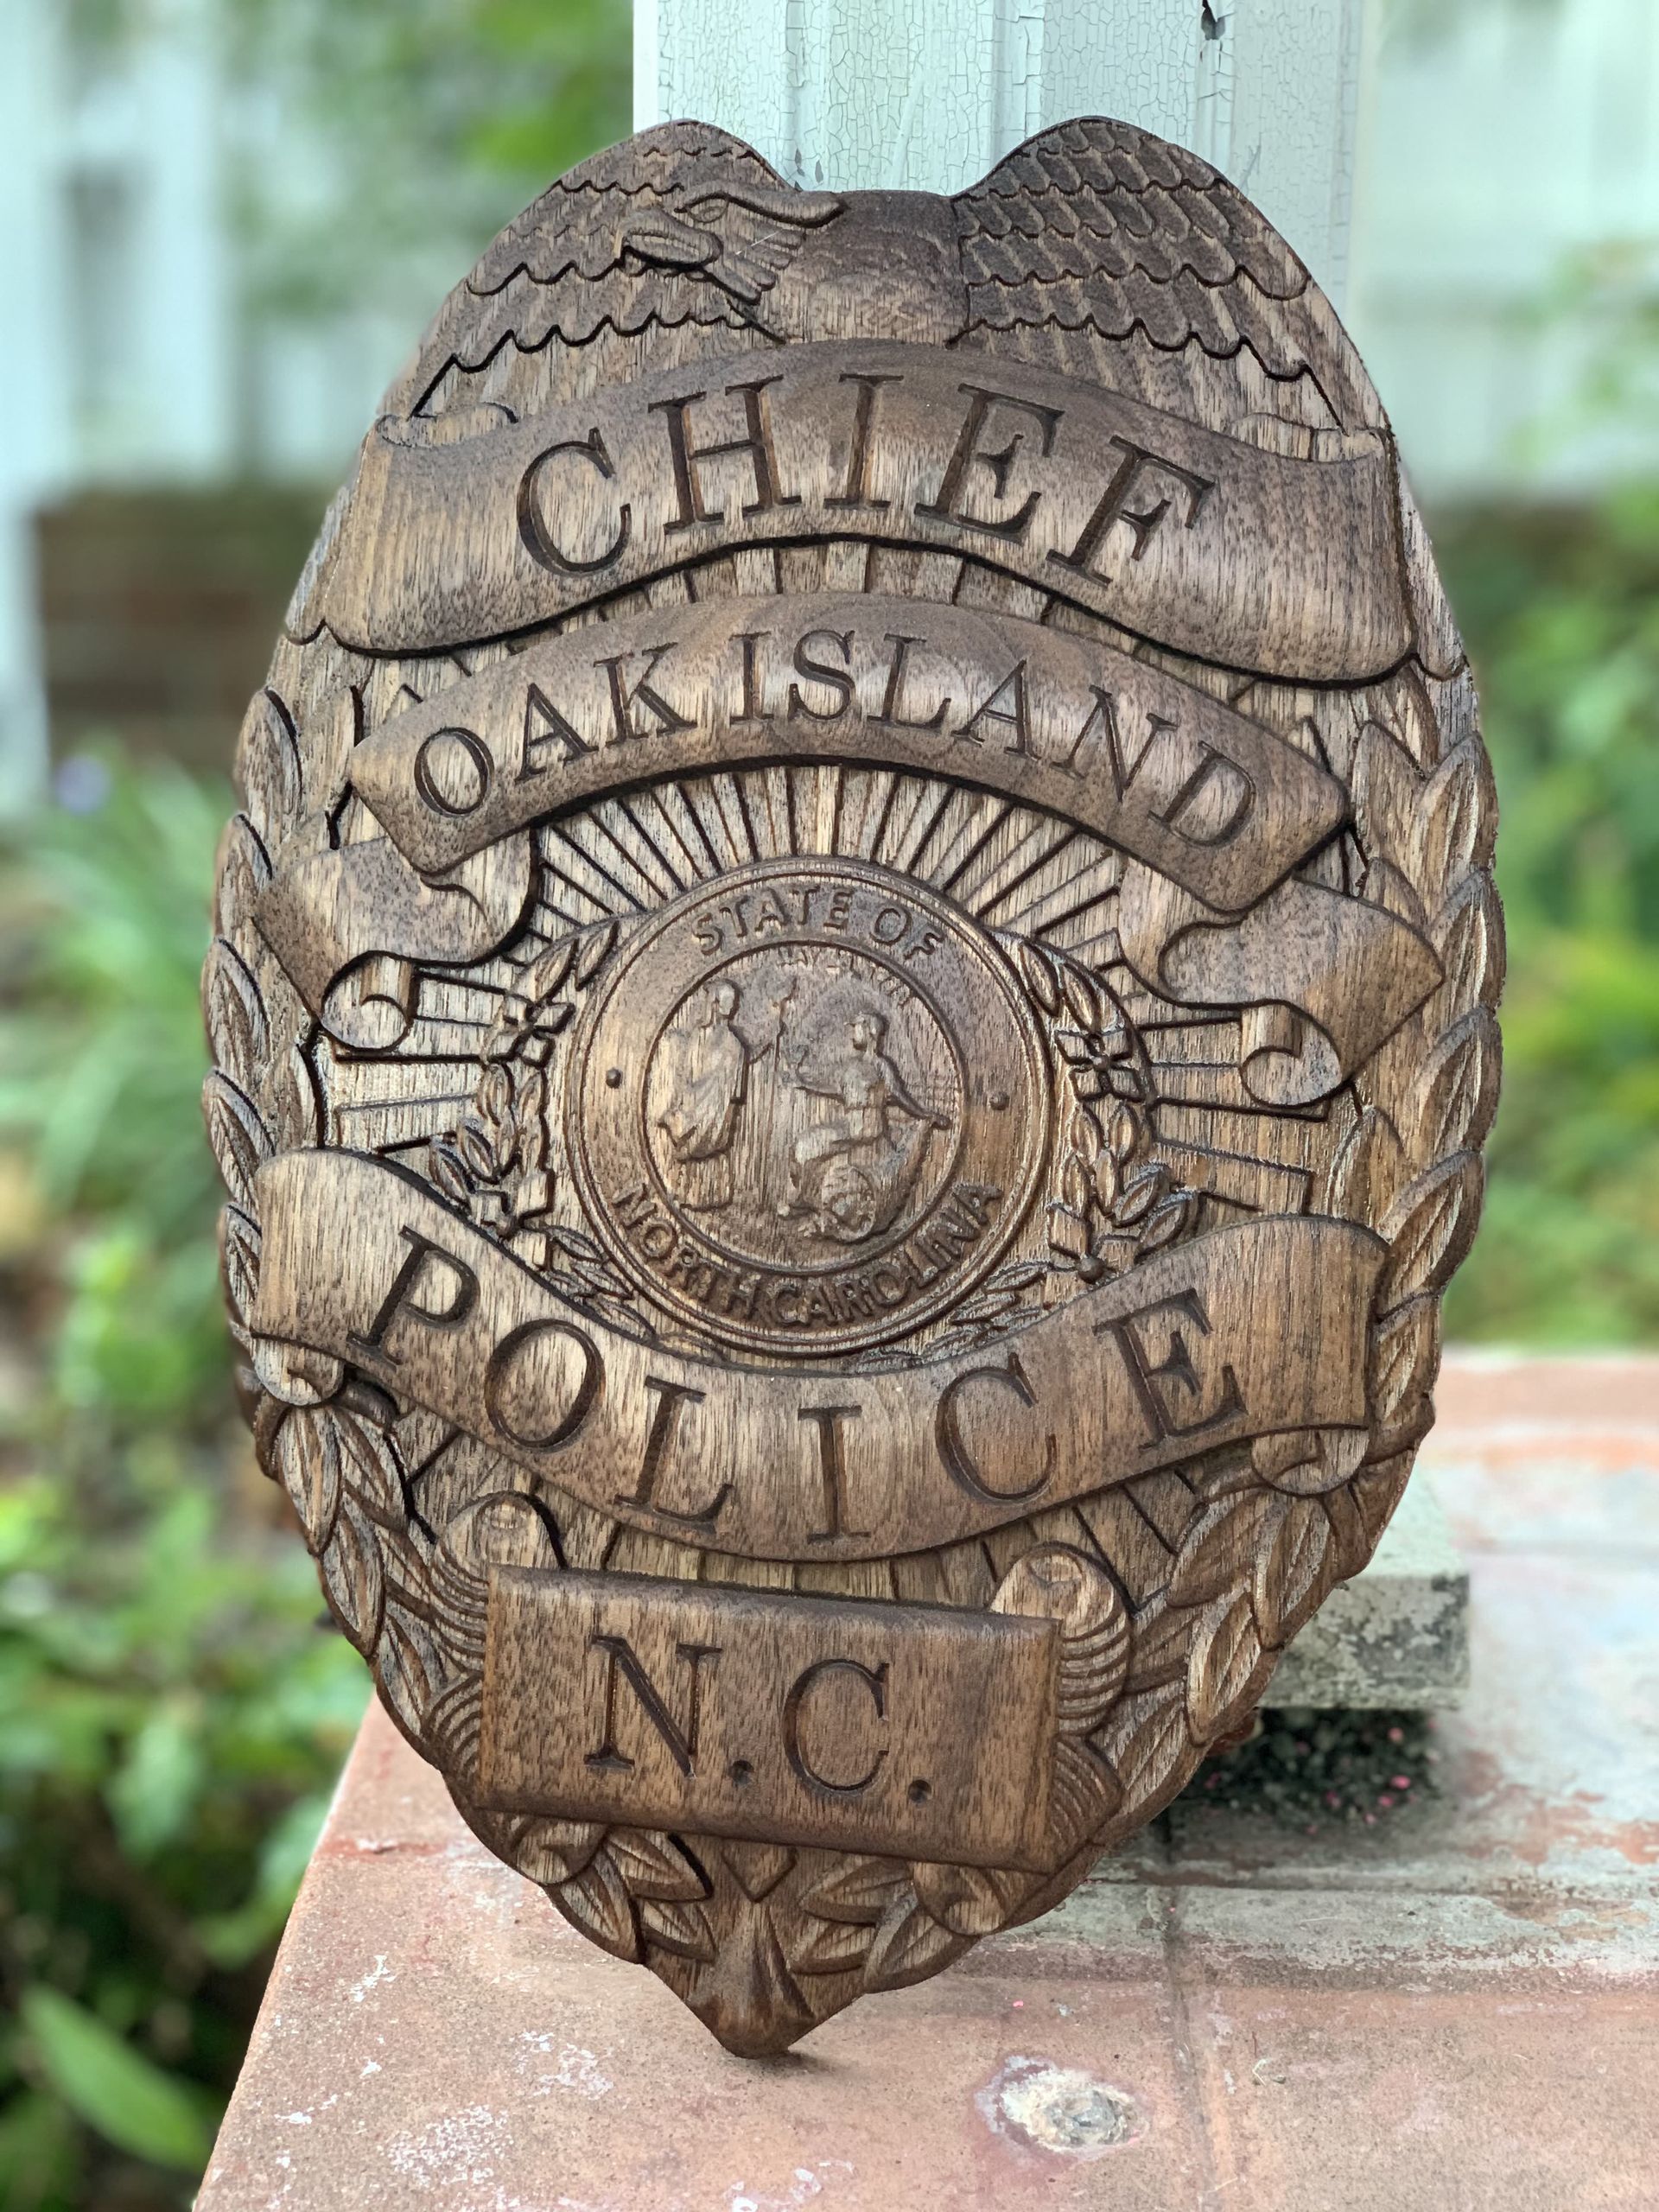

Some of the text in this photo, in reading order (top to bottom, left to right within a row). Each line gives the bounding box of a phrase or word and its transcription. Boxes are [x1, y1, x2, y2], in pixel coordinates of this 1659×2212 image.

[519, 373, 1215, 586] CHIEF
[414, 629, 1256, 848] OAK ISLAND
[690, 885, 945, 959] STATE OF
[611, 1181, 1002, 1327] NORTH CAROLINA
[346, 1224, 1249, 1545] POLICE
[583, 1633, 933, 1804] N.C.
